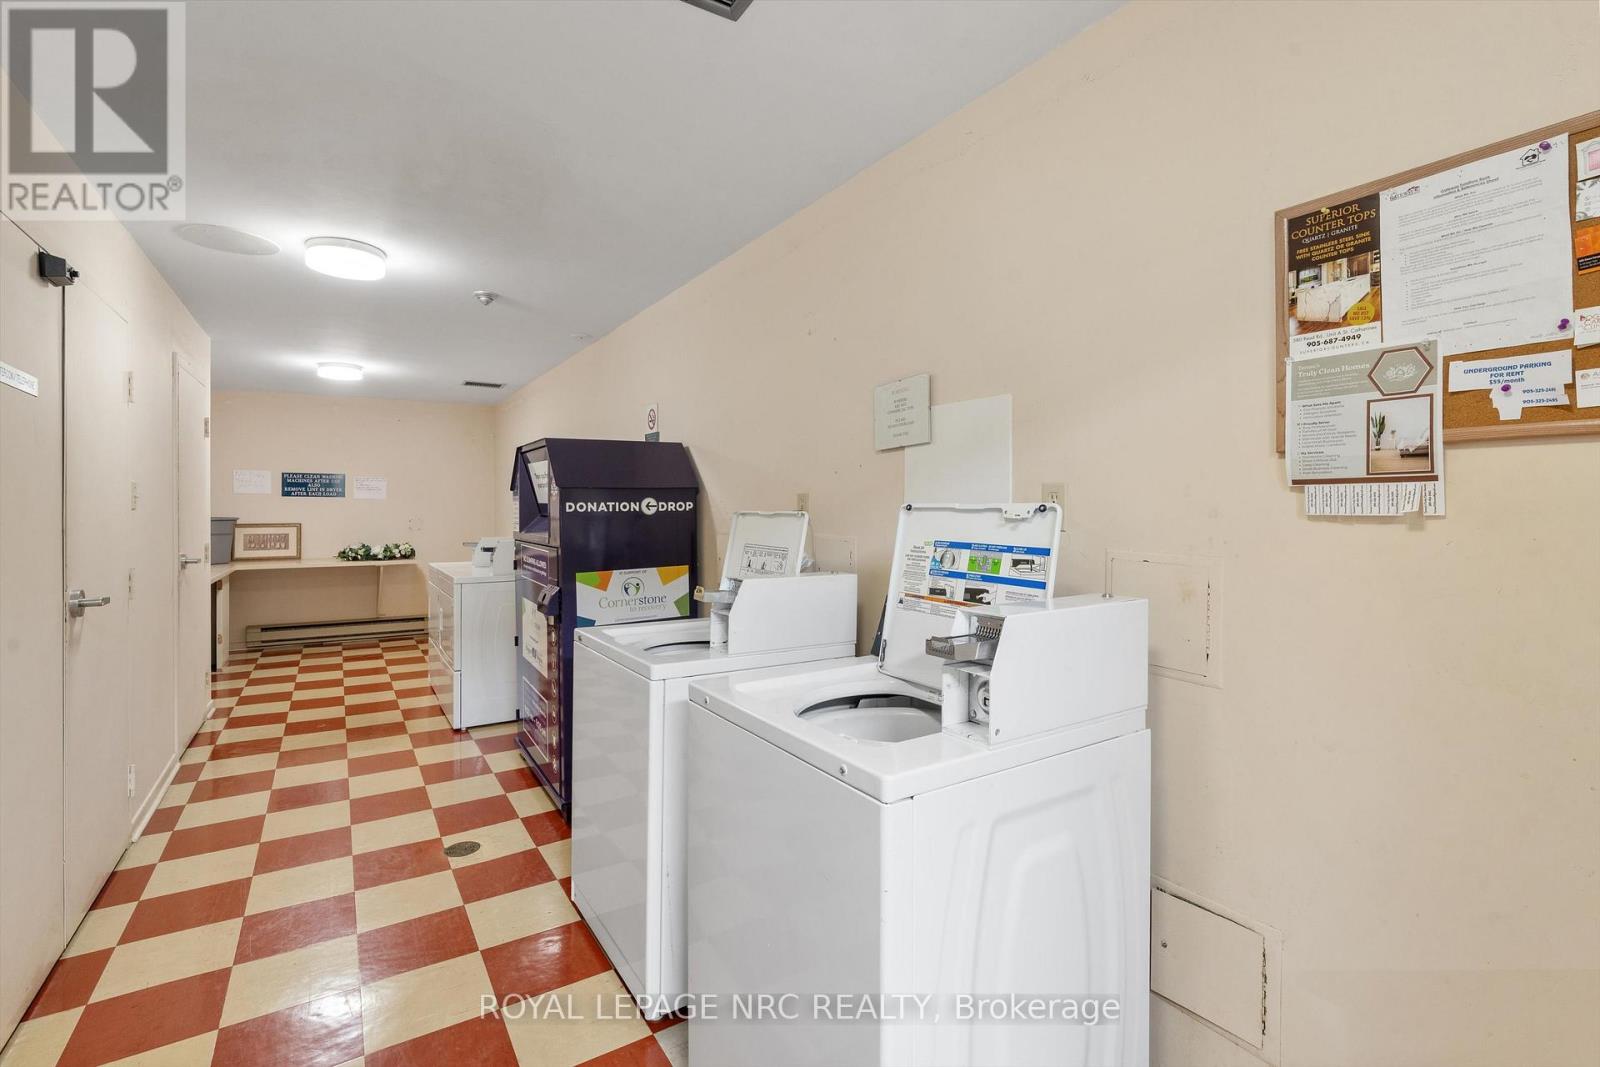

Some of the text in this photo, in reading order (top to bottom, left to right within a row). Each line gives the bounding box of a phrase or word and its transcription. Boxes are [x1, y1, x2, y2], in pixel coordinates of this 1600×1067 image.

[1306, 203, 1360, 226] SUPERIOR
[1292, 208, 1376, 240] COUNTER TOPS
[1296, 230, 1370, 254] FREE STAINLESS STEEL SINK
[1302, 232, 1326, 244] QUARTZ
[1330, 224, 1358, 236] GRANITE
[1312, 246, 1334, 256] QUARTZ
[1346, 236, 1372, 248] GRANITE
[1312, 246, 1354, 262] COUNTER TOPS
[1306, 334, 1362, 347] 905-687-4949
[1298, 370, 1317, 378] Truly
[1319, 367, 1340, 376] Clean
[1342, 363, 1370, 372] Homes
[1464, 361, 1552, 375] UNDERGROUND PARKING
[566, 502, 694, 512] DONATION DROP
[598, 596, 666, 609] Cornerstone
